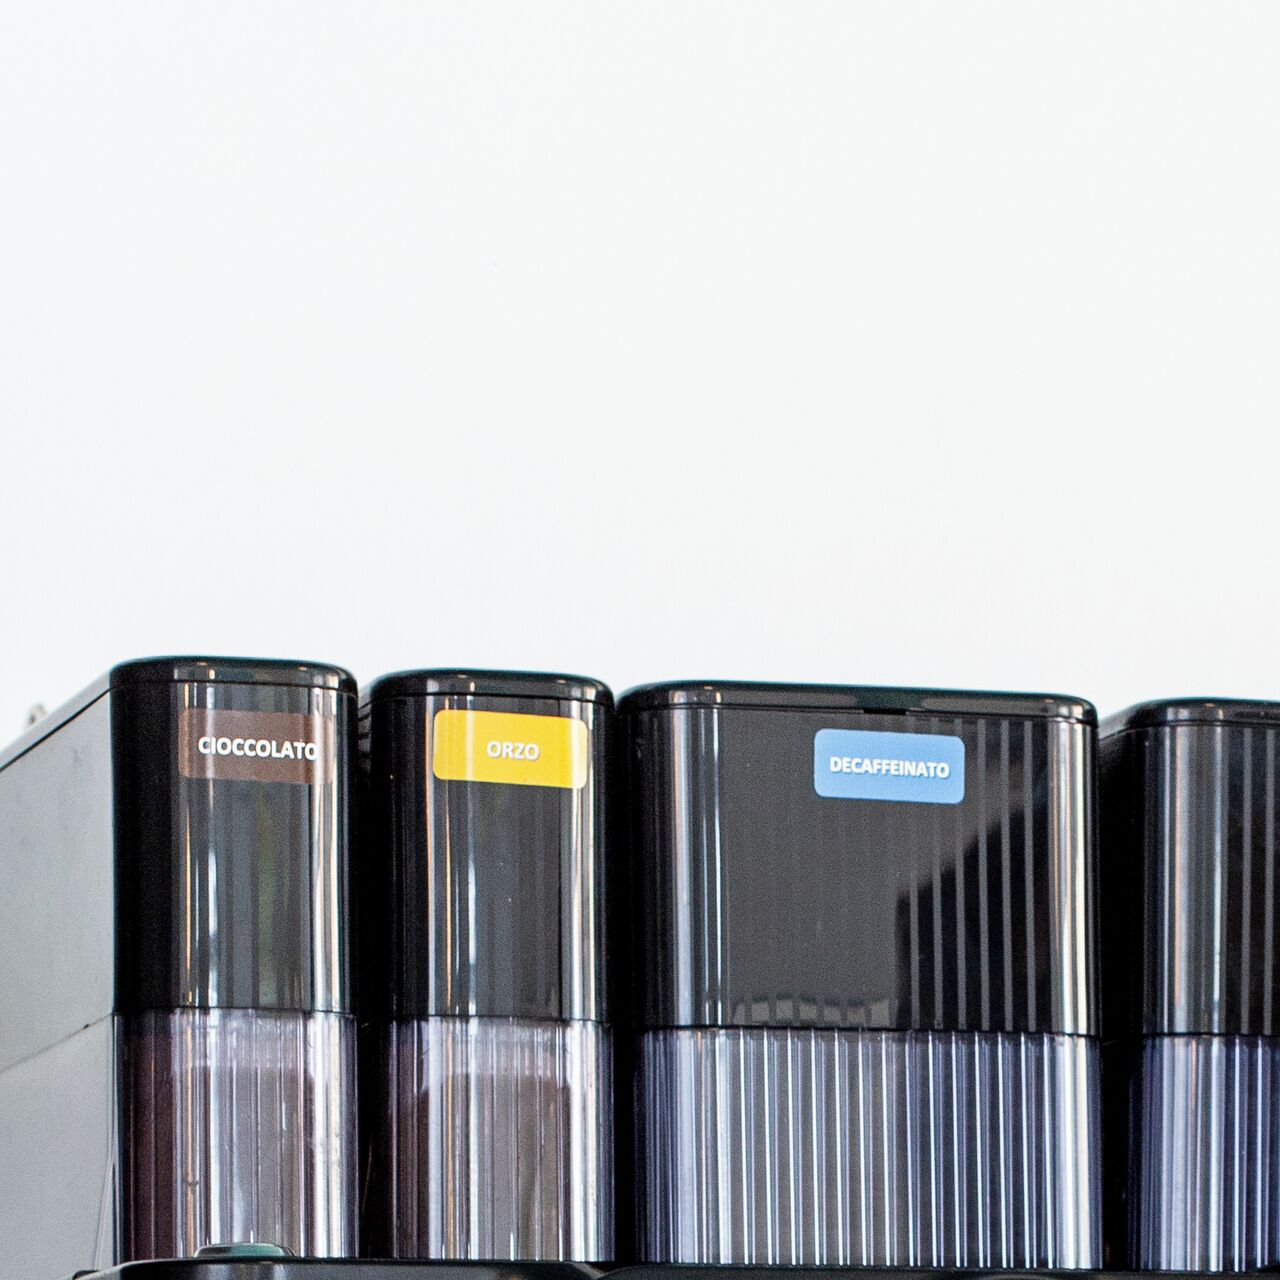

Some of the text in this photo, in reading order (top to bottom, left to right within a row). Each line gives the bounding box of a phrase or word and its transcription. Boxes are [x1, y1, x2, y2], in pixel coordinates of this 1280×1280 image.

[198, 736, 320, 761] CIOCCOLATO
[486, 740, 540, 761] ORZO
[829, 756, 950, 778] DECAFFEINATO
